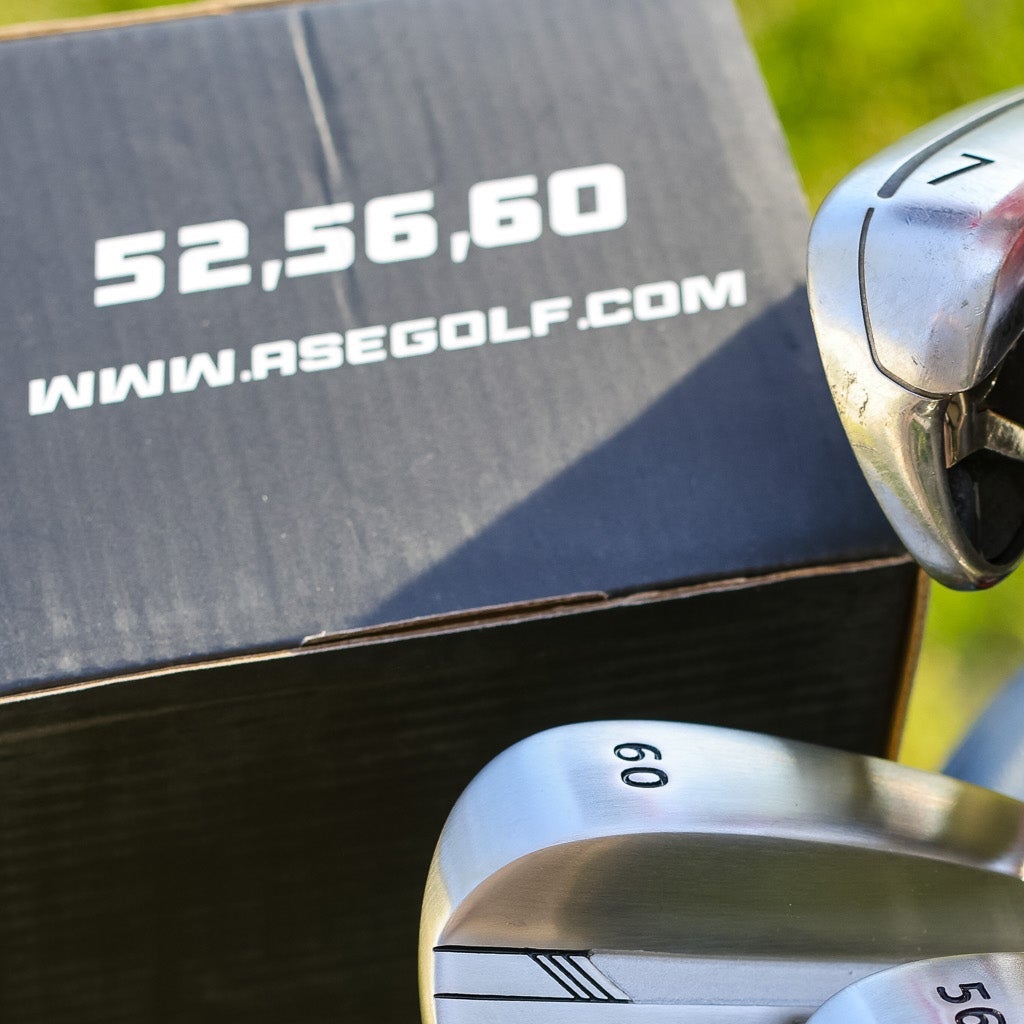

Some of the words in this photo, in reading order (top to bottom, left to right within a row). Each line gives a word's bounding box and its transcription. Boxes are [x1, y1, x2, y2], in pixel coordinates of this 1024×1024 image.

[927, 153, 995, 185] 7
[93, 163, 628, 307] 52,56,60
[29, 269, 747, 416] WWW.ASEGOLF.COM
[613, 742, 669, 789] 60
